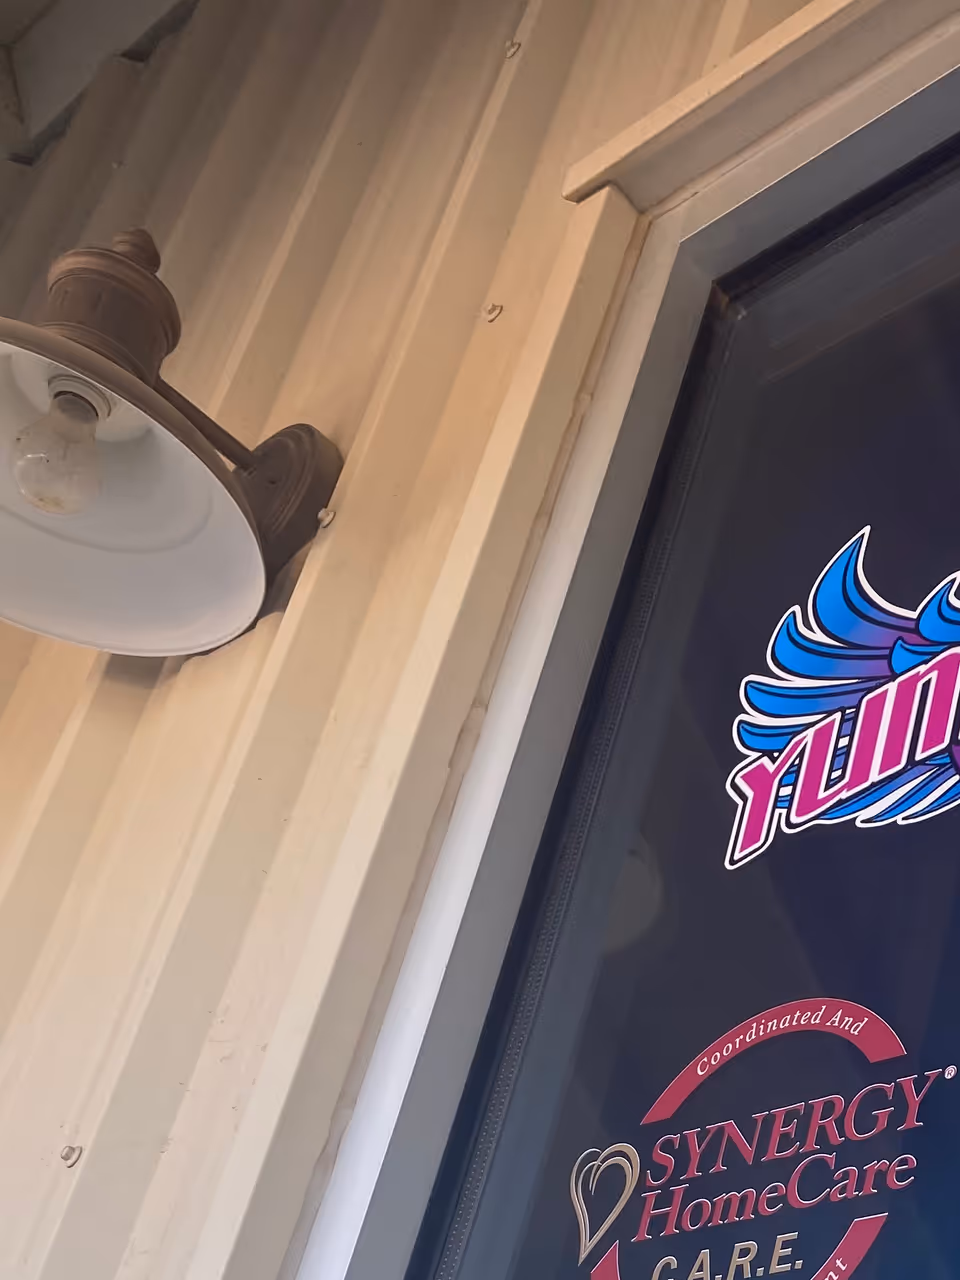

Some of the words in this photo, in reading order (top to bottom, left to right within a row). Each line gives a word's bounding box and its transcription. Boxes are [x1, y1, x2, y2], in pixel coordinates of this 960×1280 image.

[696, 1005, 827, 1076] Coordinated
[826, 1008, 869, 1035] And
[631, 1152, 917, 1242] HomeCare
